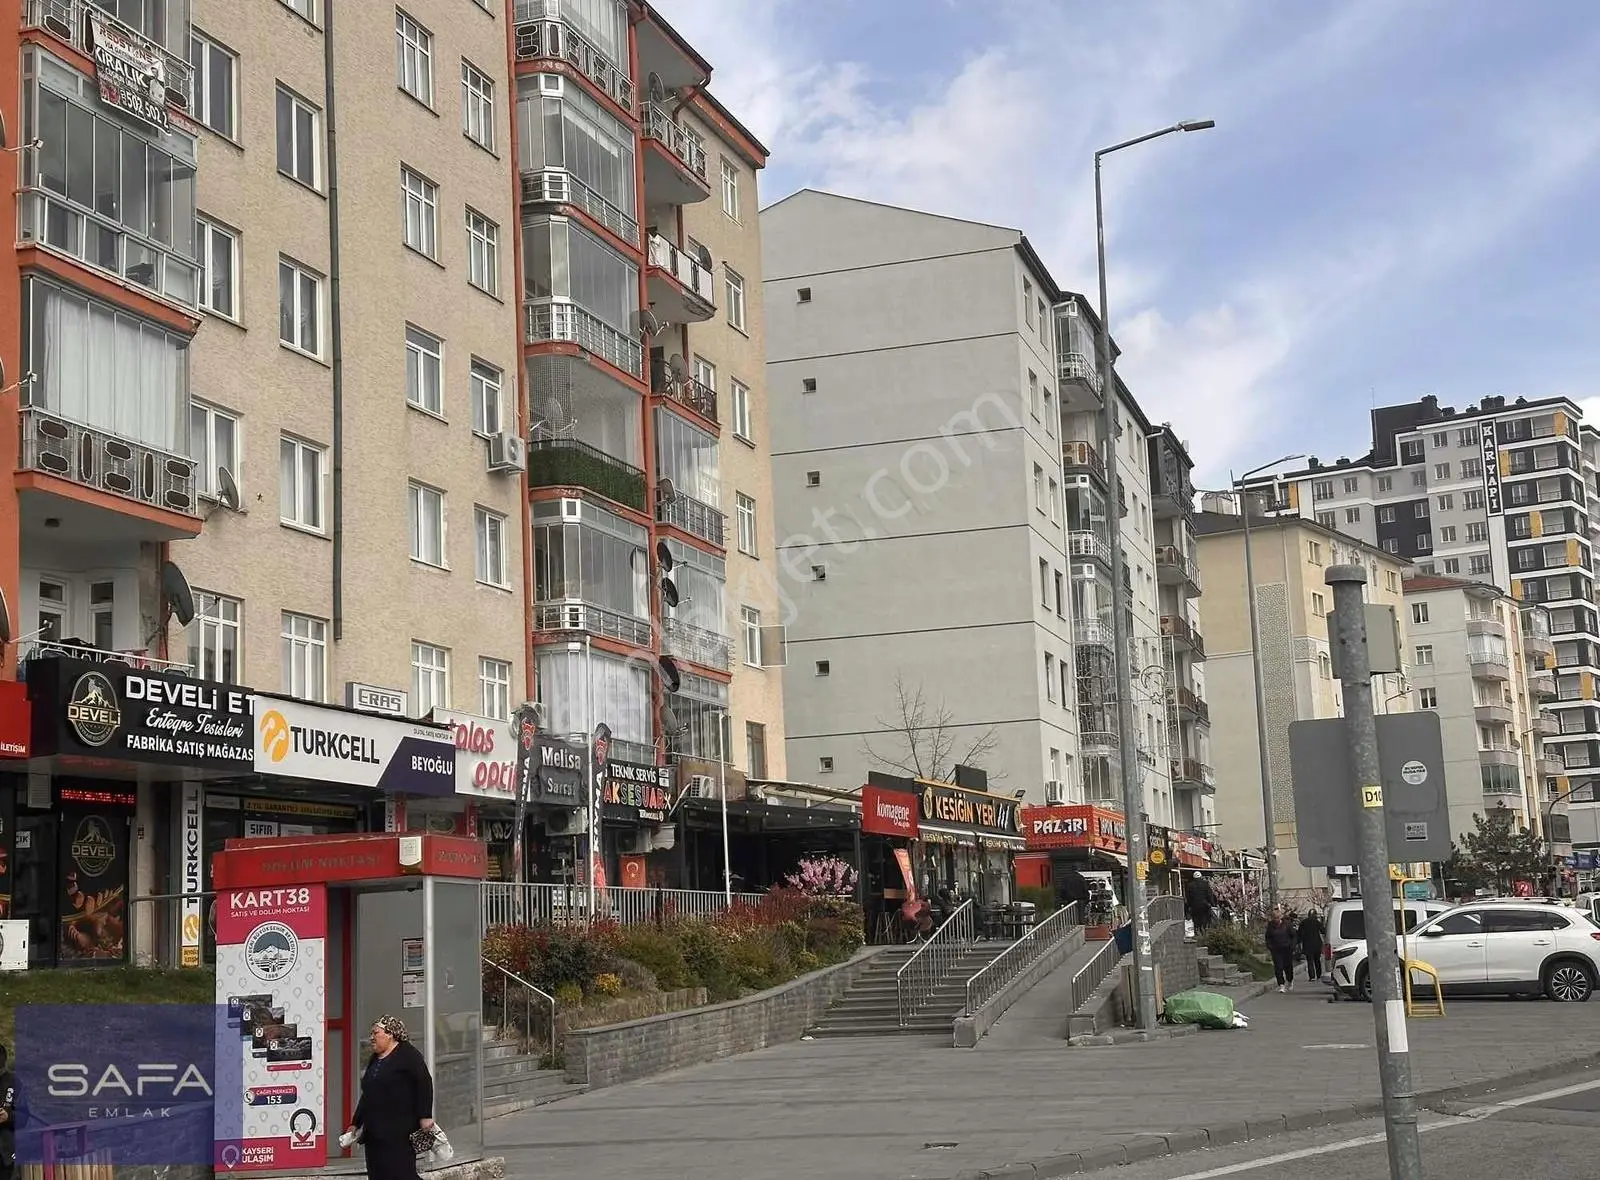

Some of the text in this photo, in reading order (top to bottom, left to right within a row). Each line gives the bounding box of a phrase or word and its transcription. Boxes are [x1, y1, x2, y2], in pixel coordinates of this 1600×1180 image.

[95, 46, 149, 88] KİRALIK
[1482, 425, 1500, 510] KARYAPI
[126, 675, 255, 716] DEVELİ ET
[146, 707, 244, 738] Entegre Tesisleri
[127, 734, 173, 753] FABRİKA
[176, 740, 205, 759] SATIŞ
[290, 726, 380, 764] TURKCELL
[411, 755, 453, 775] BEYOĞLU
[541, 746, 581, 771] Melisa
[877, 795, 910, 825] komagene
[977, 800, 997, 827] YERİ
[250, 823, 273, 835] SIFIR
[187, 789, 199, 909] TURKCELL
[230, 888, 310, 910] KART38
[259, 908, 281, 916] DOLUM
[282, 906, 310, 914] NOKTASI
[266, 1095, 282, 1105] 153
[242, 1155, 274, 1164] ULAŞIM
